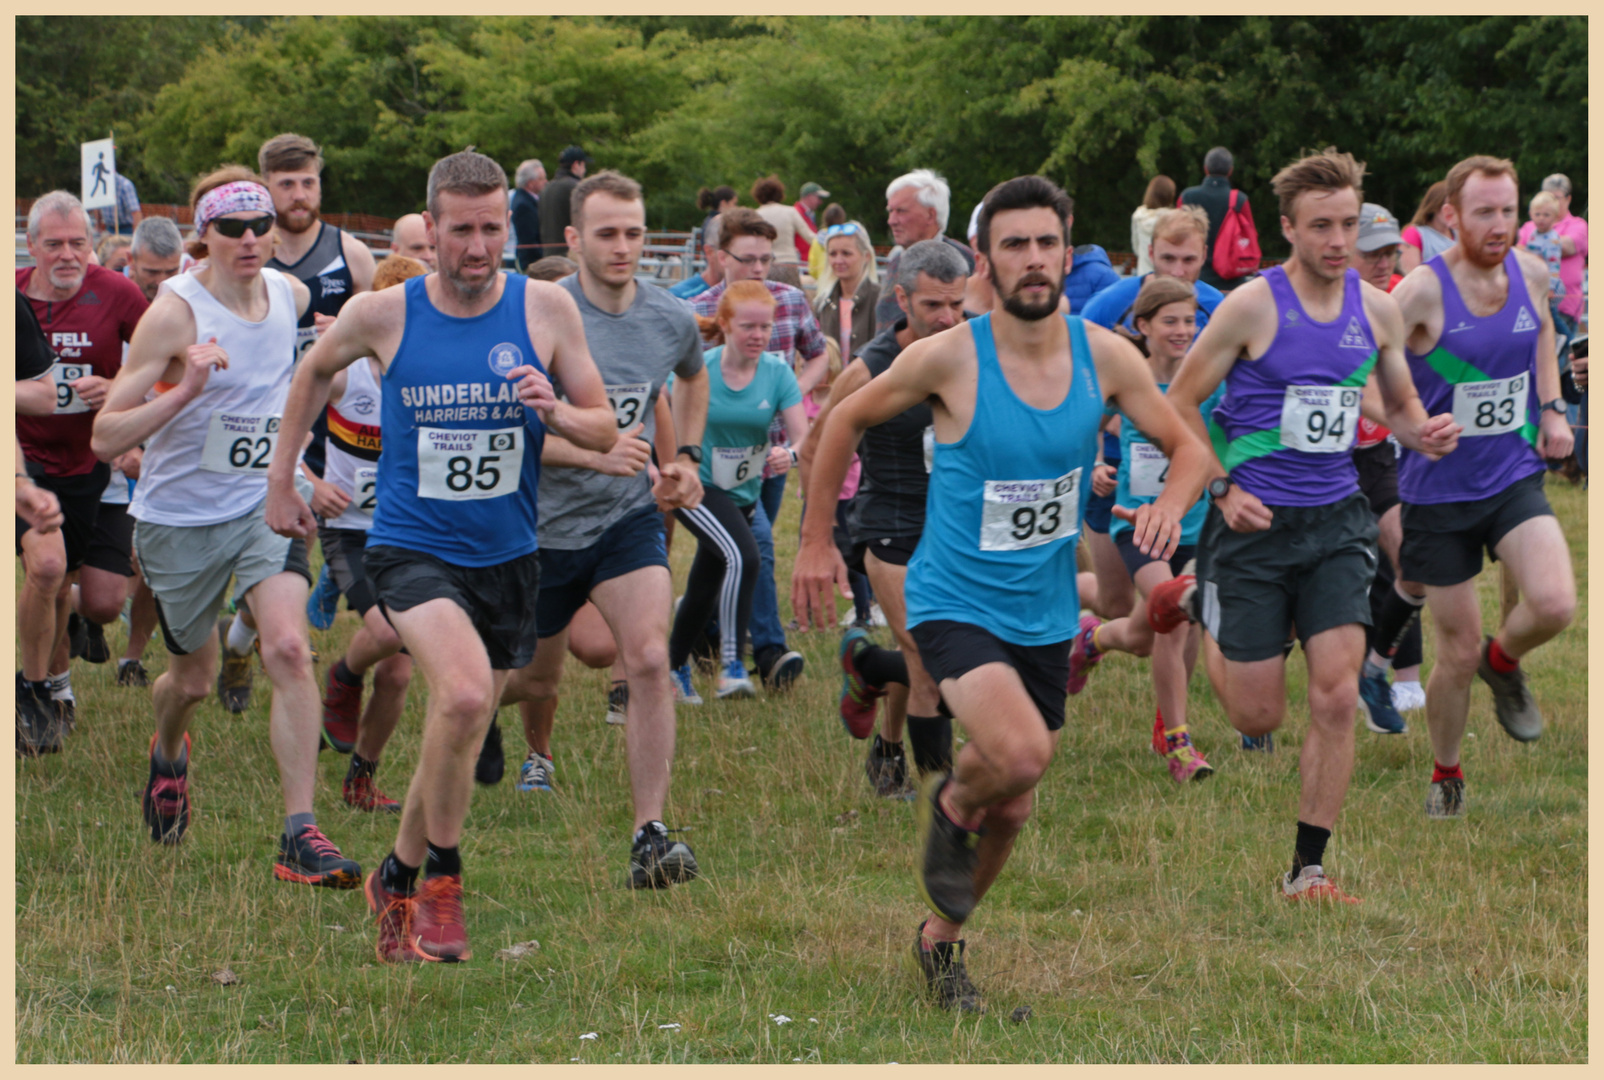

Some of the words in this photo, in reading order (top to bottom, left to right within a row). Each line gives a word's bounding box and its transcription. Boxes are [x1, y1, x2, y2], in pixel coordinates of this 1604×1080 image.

[52, 332, 93, 347] FELL
[1344, 335, 1363, 345] FR
[1462, 382, 1502, 392] CHEVIOT
[57, 383, 73, 408] 9
[400, 383, 524, 408] SUNDERLAN
[1294, 388, 1334, 397] CHEVIOT
[1466, 391, 1498, 399] TRAILS
[1299, 397, 1330, 406] TRAILS
[415, 406, 487, 423] HARRIERS
[491, 406, 501, 419] &
[503, 405, 523, 419] AC
[1475, 398, 1515, 428] 83
[220, 414, 261, 424] CHEVIOT
[223, 423, 256, 433] TRAILS
[1305, 410, 1346, 444] 94
[428, 432, 478, 441] CHEVIOT
[433, 442, 473, 451] TRAILS
[229, 436, 271, 468] 62
[446, 455, 501, 492] 85
[736, 460, 749, 481] 6
[993, 483, 1046, 493] CHEVIOT
[999, 493, 1041, 503] TRAILS
[1011, 501, 1061, 541] 93
